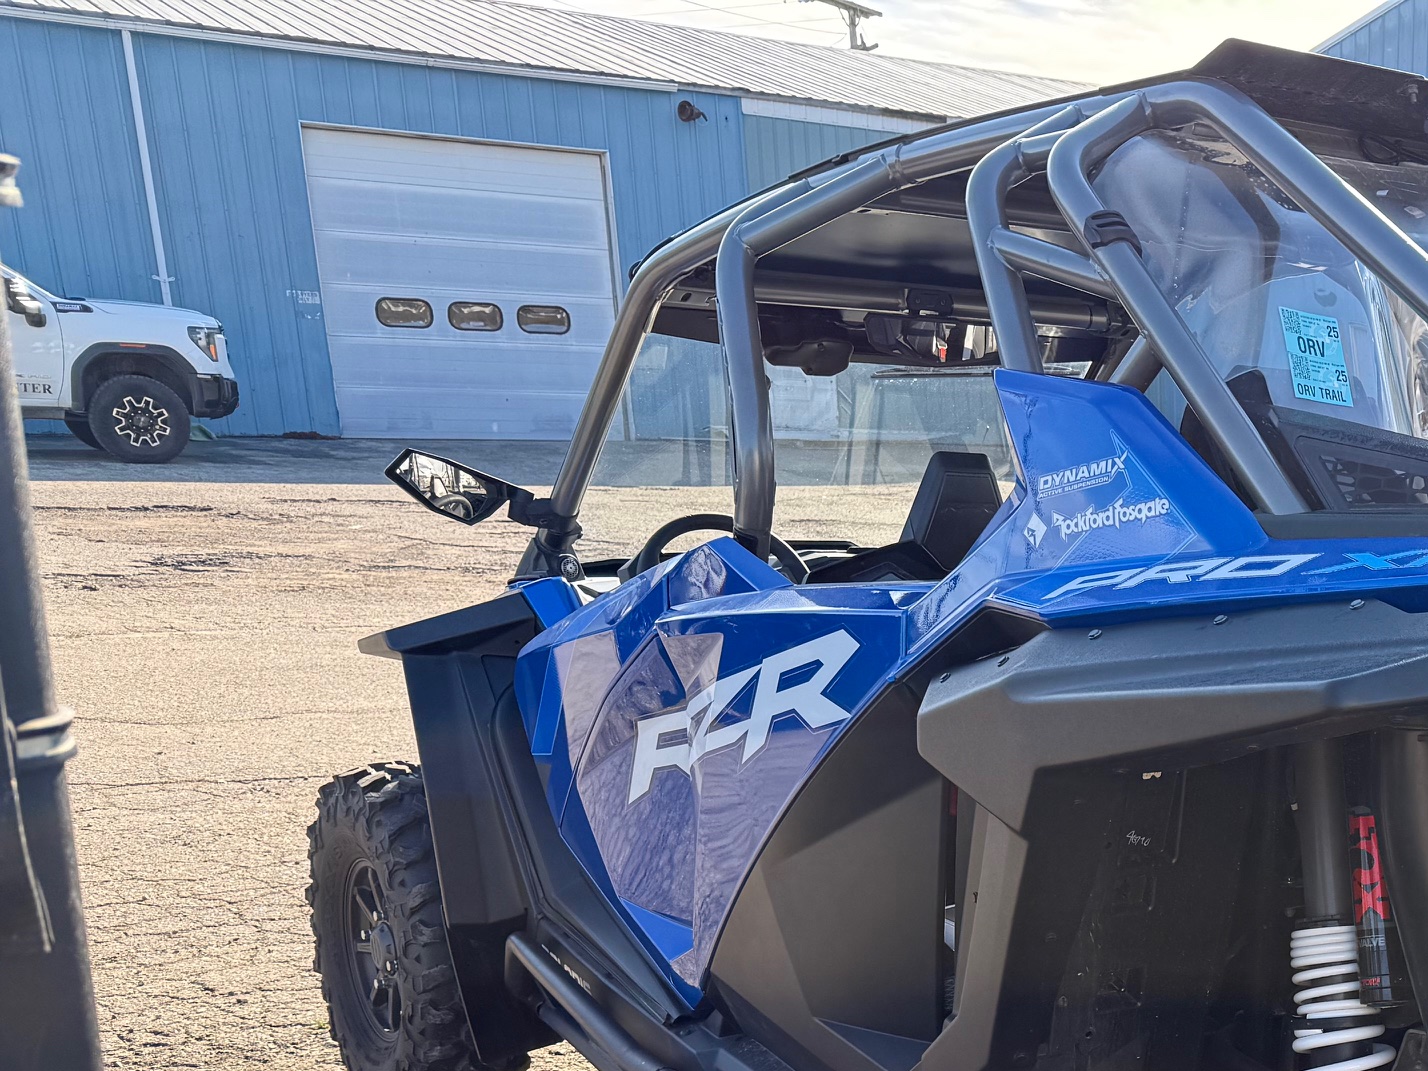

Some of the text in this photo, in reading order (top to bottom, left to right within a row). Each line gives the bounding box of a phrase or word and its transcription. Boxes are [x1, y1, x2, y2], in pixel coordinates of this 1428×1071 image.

[1326, 325, 1340, 339] 25
[1297, 335, 1325, 358] ORV
[1335, 369, 1348, 383] 25
[1297, 383, 1347, 403] ORV TRAIL
[1038, 450, 1128, 491] DYNAMIX
[1038, 476, 1110, 499] ACTIVE SUSPENSION
[1041, 552, 1324, 600] PRO
[627, 628, 862, 806] RZR
[1349, 815, 1392, 925] FOX
